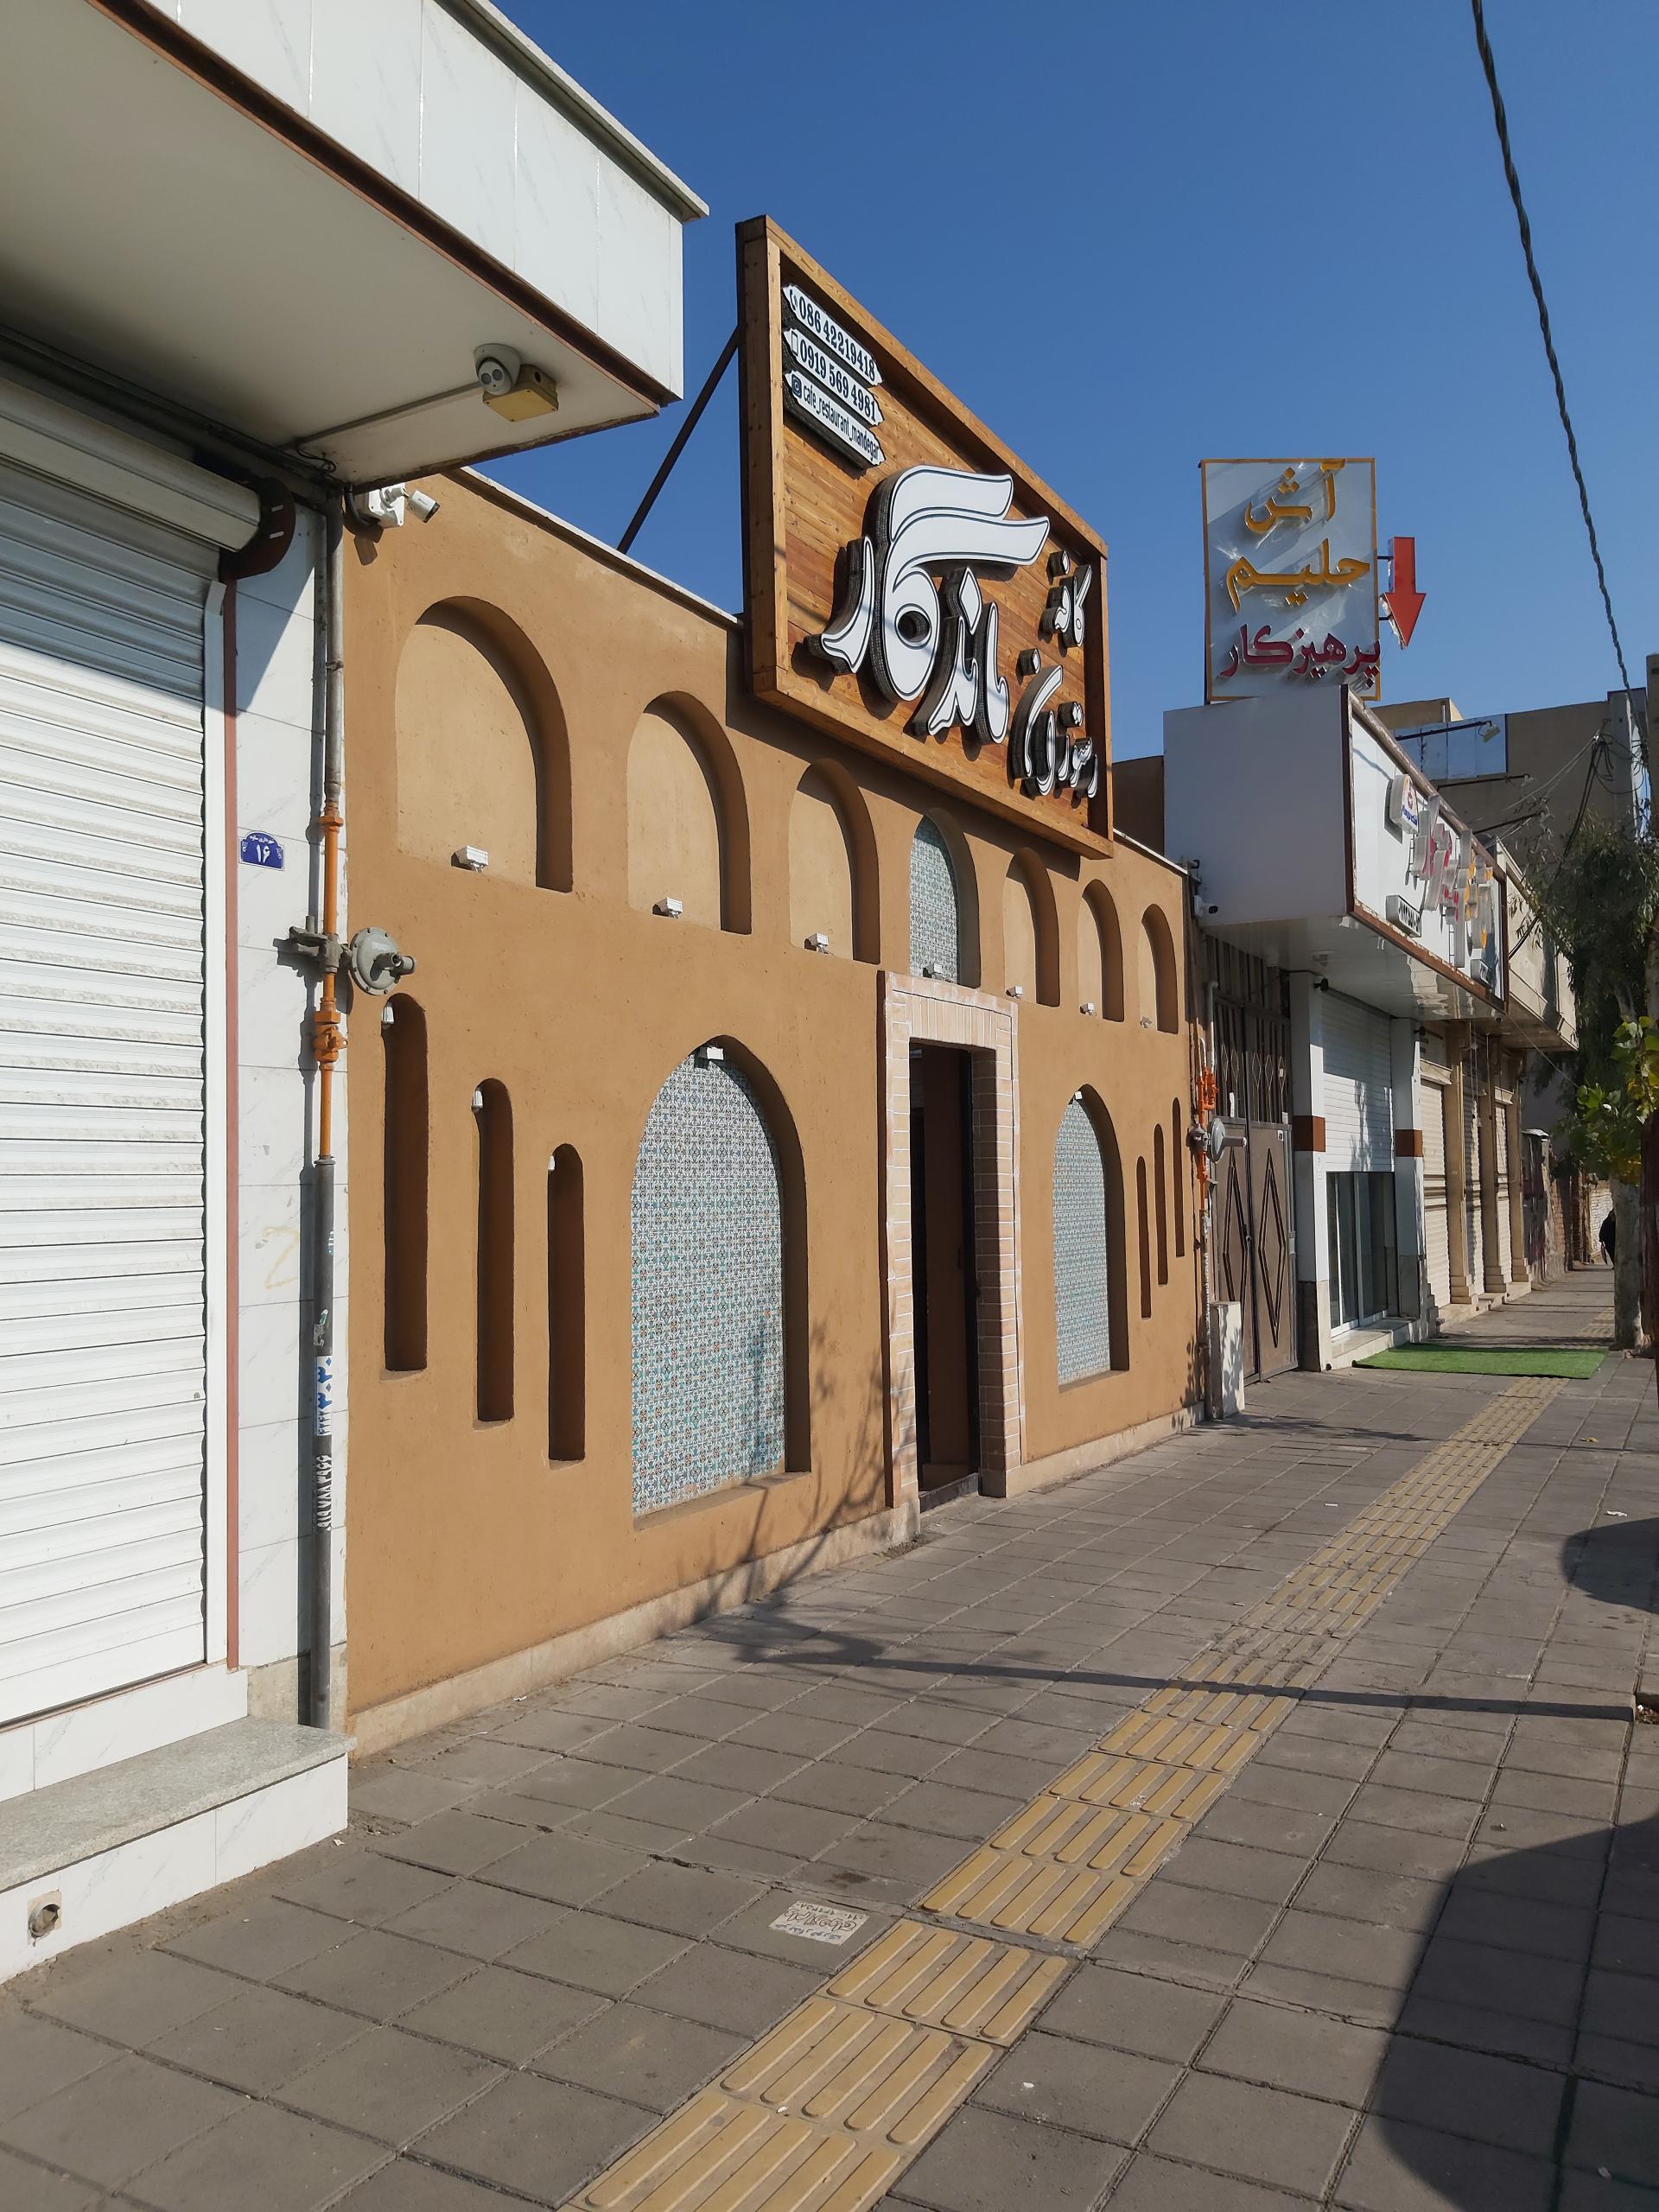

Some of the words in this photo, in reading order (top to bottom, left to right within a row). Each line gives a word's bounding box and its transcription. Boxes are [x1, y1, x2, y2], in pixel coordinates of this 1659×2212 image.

[798, 296, 822, 334] 086
[823, 320, 876, 382] 42219418
[799, 339, 827, 379] 0919
[829, 365, 849, 400] 569
[850, 385, 877, 423] 4981
[803, 385, 880, 461] cafe_restaurant_mandegar
[1244, 459, 1345, 534] آش
[820, 464, 1051, 744] ماندگار
[1053, 550, 1092, 647] کافه
[1226, 537, 1370, 614] حلیم
[1219, 623, 1381, 689] پرهیزکار
[1024, 648, 1098, 798] رستوران
[256, 843, 270, 864] ۱۶
